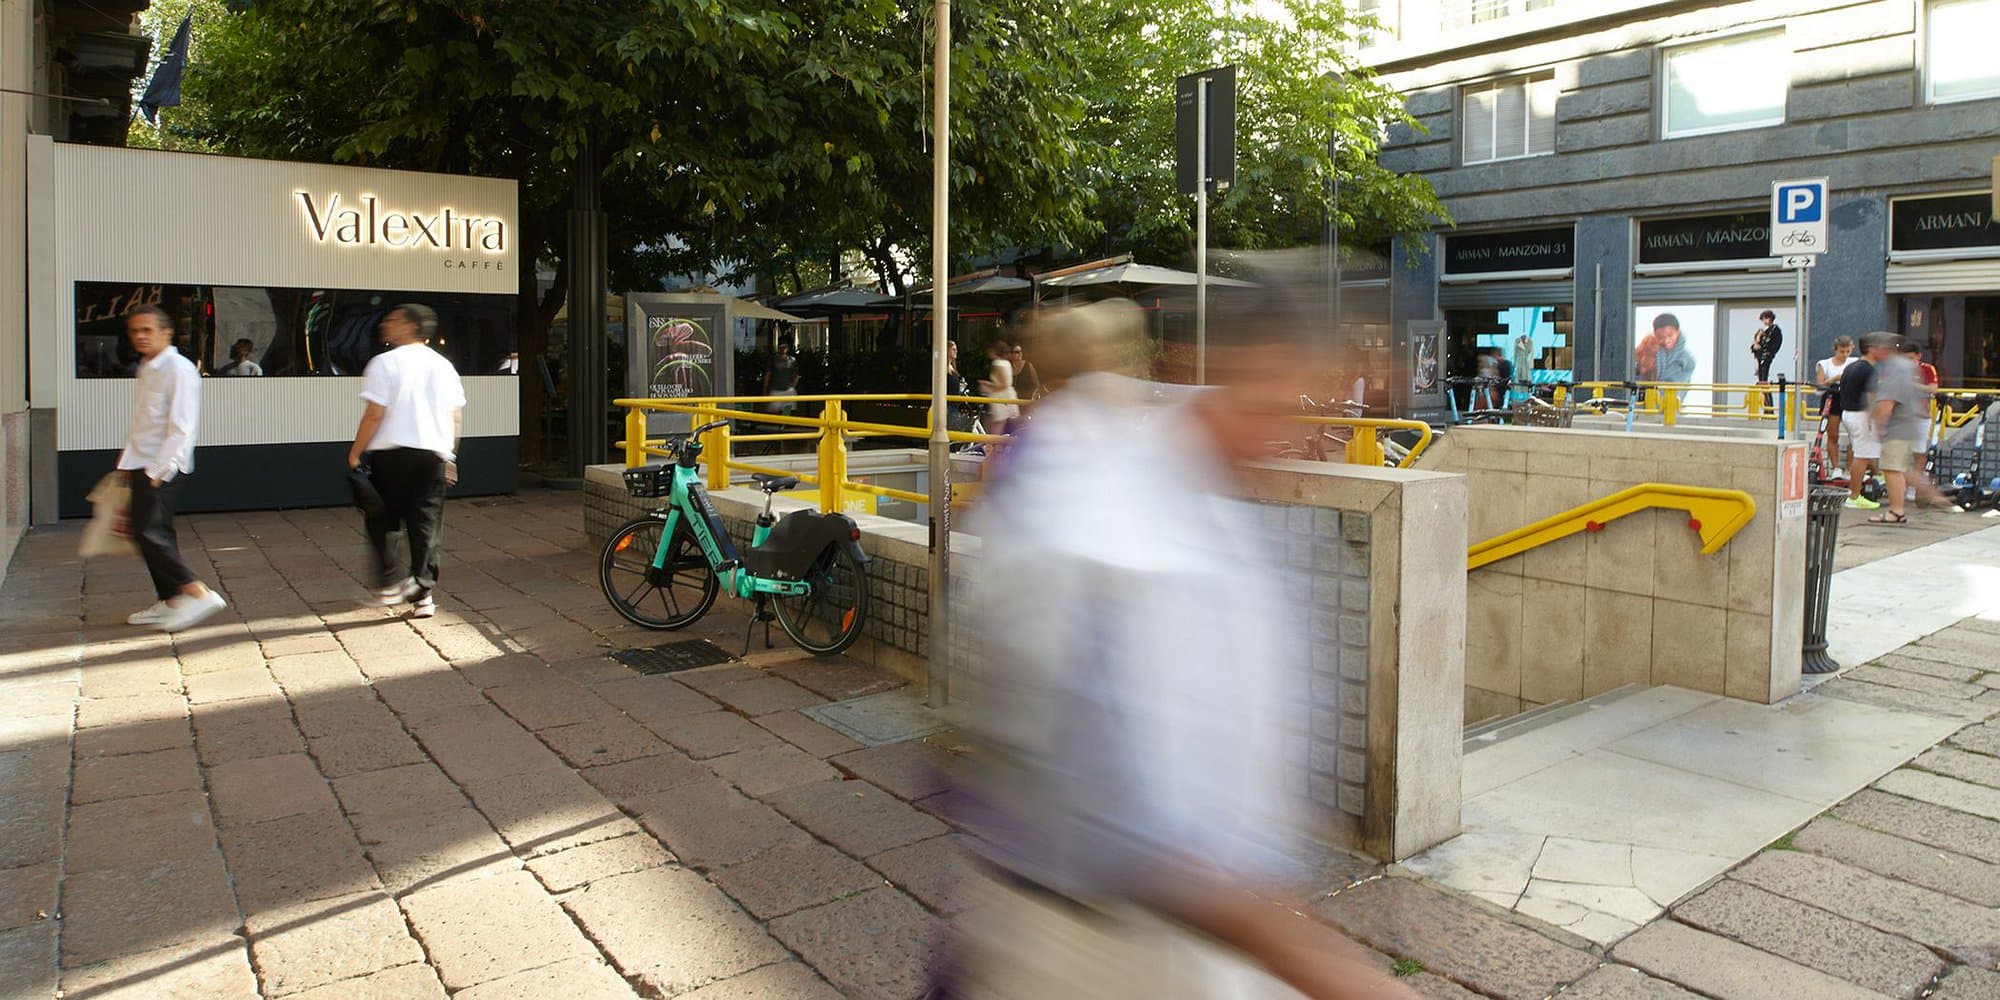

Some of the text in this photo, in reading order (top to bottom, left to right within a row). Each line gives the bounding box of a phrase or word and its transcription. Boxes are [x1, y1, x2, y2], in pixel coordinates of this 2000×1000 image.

[1787, 188, 1814, 220] P
[295, 192, 504, 250] Valextra
[1915, 212, 1983, 231] ARMANI
[1644, 232, 1693, 248] ARMANI
[1706, 227, 1770, 243] MANZO
[1457, 247, 1491, 260] ARMANI
[1499, 244, 1551, 257] MANZONI
[1553, 243, 1567, 254] 31
[443, 259, 504, 271] CAFFÈ
[692, 511, 724, 571] TIER
